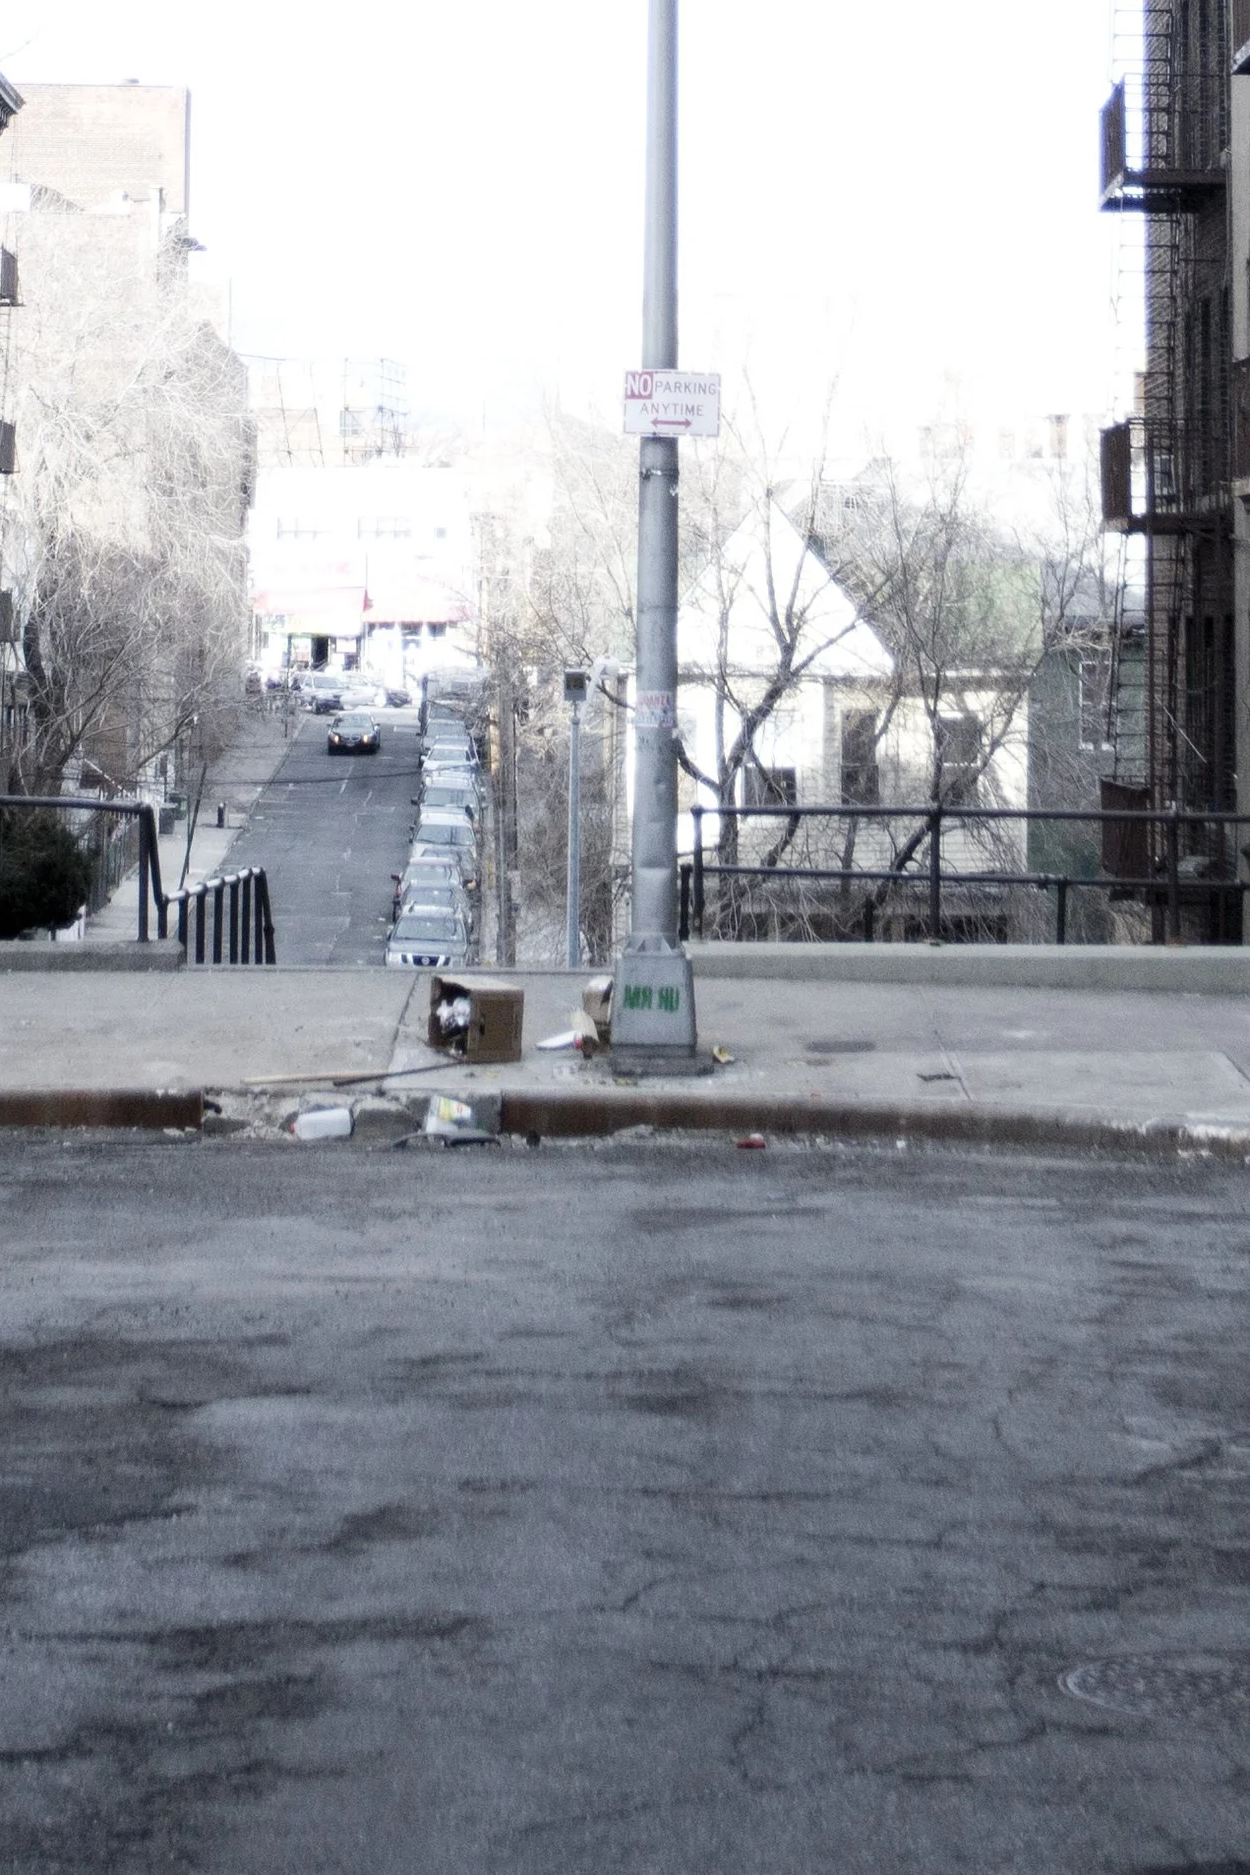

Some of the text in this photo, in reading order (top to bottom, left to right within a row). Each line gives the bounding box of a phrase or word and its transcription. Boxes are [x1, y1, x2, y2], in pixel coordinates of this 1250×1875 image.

[627, 374, 717, 397] NO PARKING
[640, 403, 705, 416] ANYTIME
